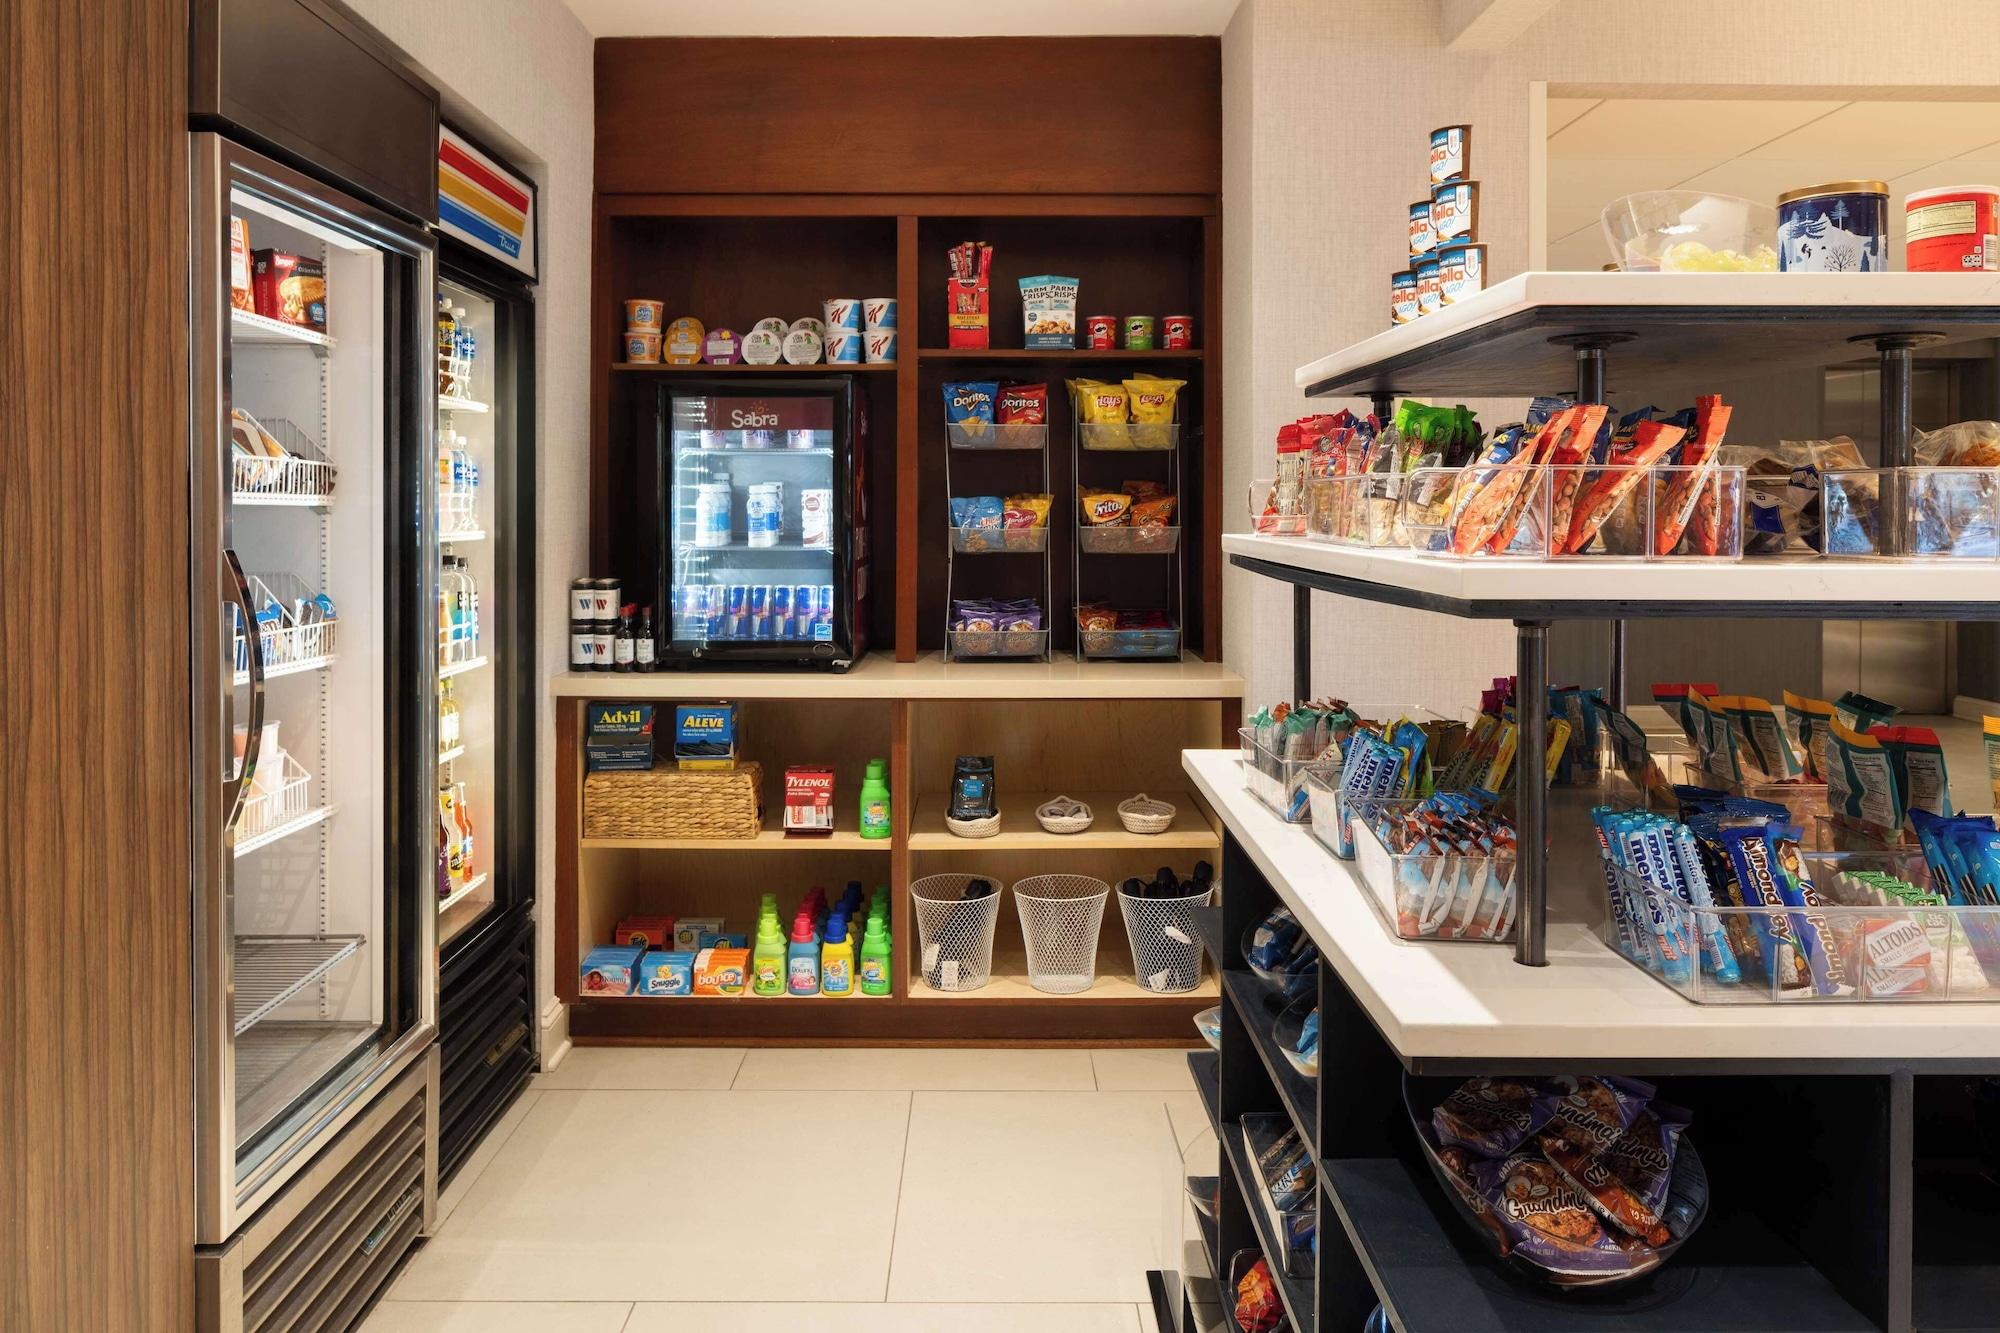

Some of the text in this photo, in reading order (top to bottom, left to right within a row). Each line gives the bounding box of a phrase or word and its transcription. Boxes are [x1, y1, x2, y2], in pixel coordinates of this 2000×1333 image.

[1023, 286, 1047, 295] PARM
[1051, 284, 1075, 293] PARM
[953, 392, 990, 407] Doritos
[1001, 398, 1040, 409] Doritos
[731, 409, 778, 428] Sabra
[1095, 501, 1122, 516] Fritos
[600, 710, 641, 723] Advil
[683, 715, 725, 728] ALEVE
[786, 776, 830, 788] TYLENOL
[1680, 842, 1701, 885] mentos
[1869, 921, 1923, 960] ALTOIDS
[651, 978, 681, 990] Snuggle
[699, 971, 736, 985] bounce
